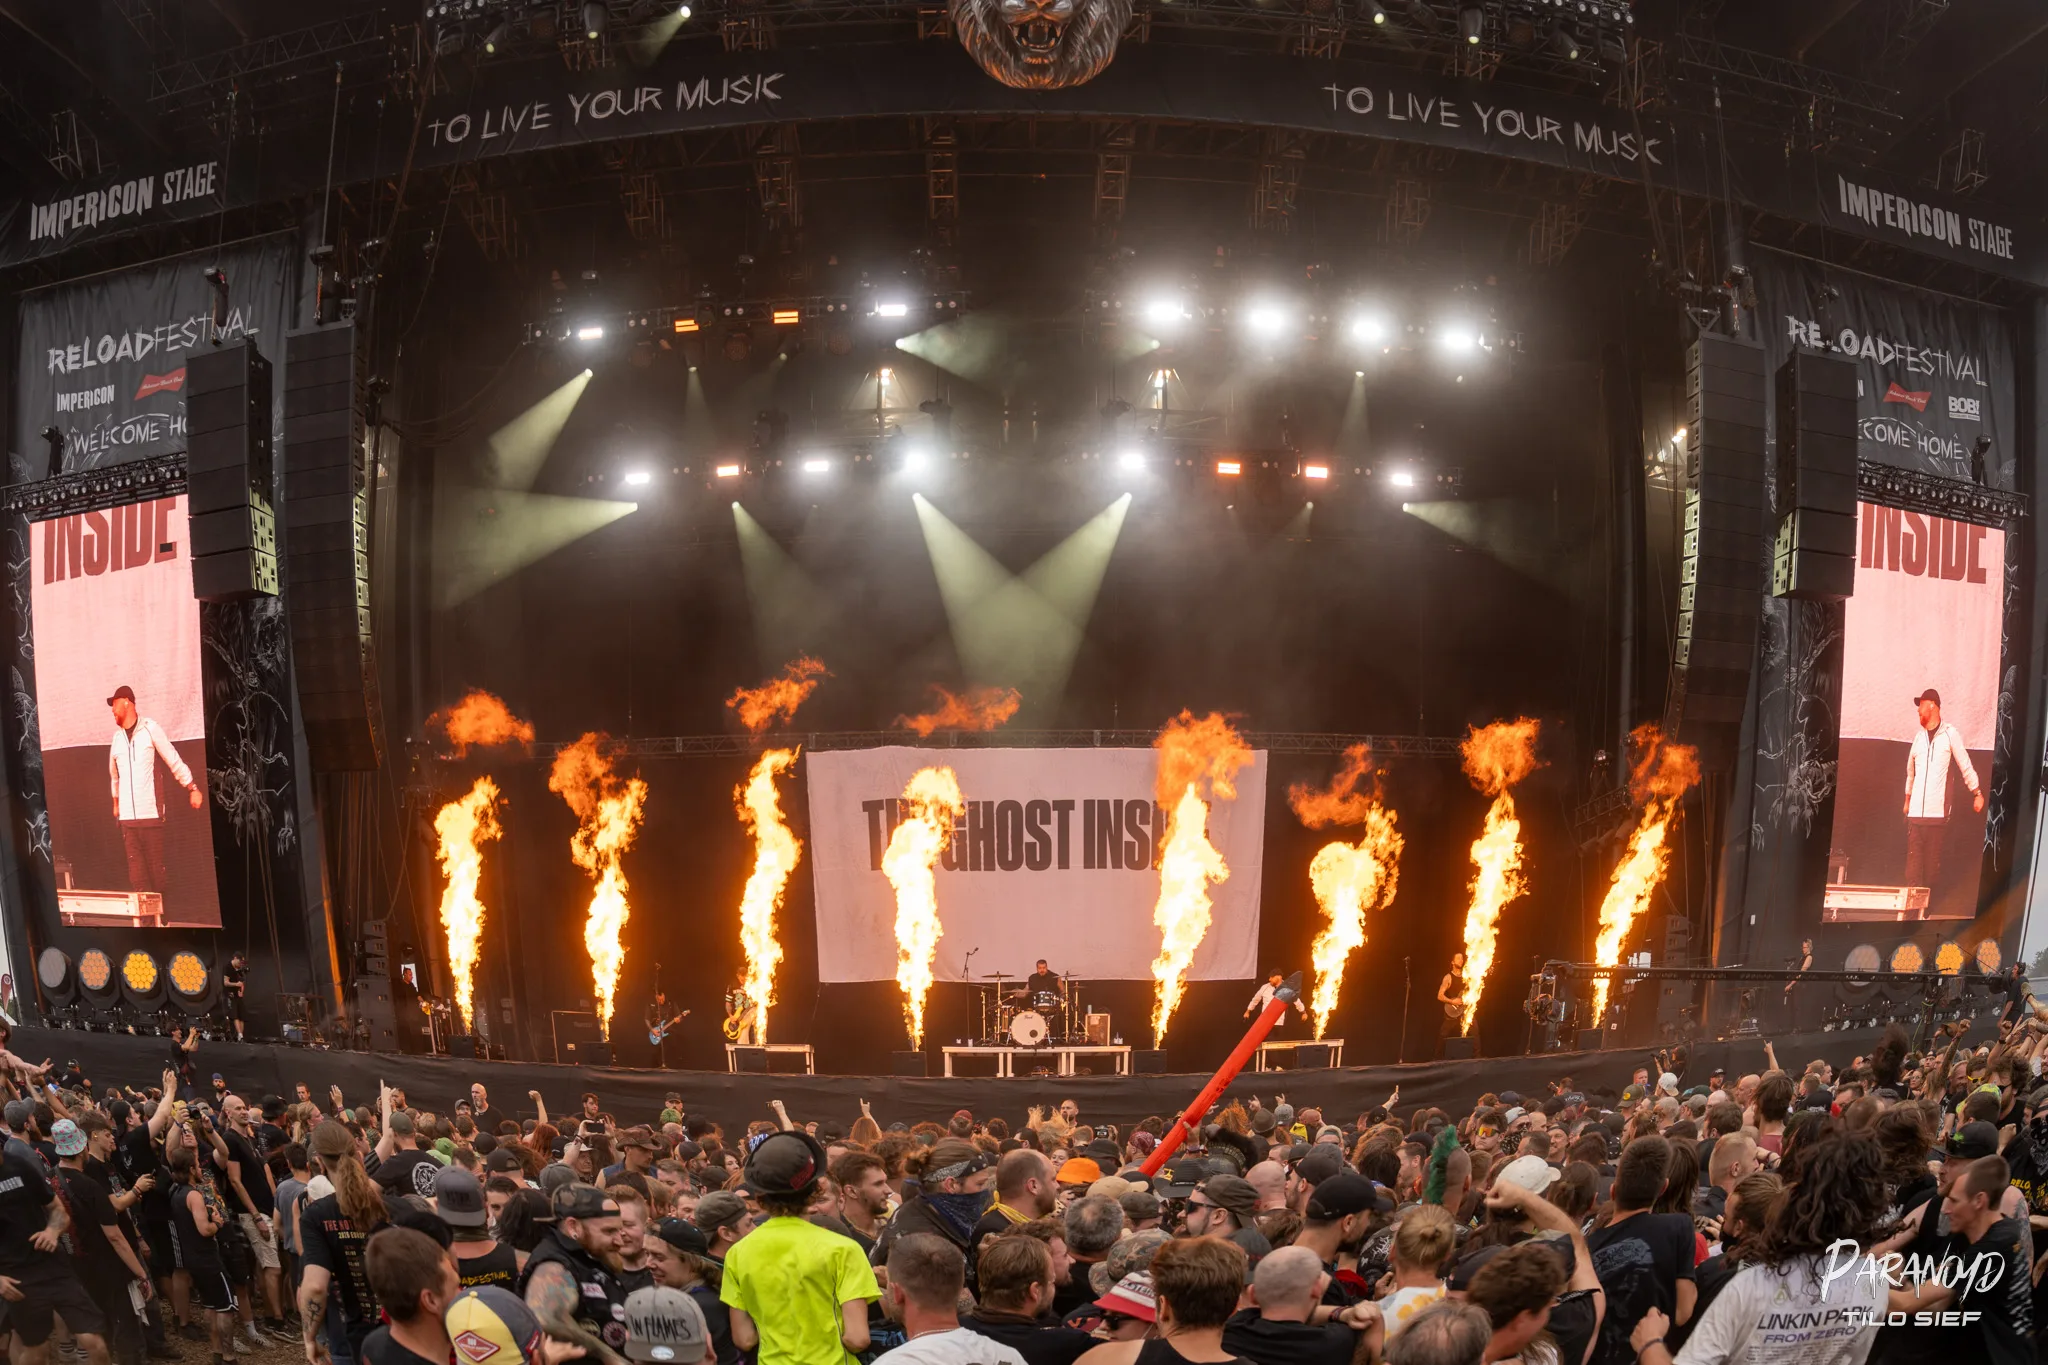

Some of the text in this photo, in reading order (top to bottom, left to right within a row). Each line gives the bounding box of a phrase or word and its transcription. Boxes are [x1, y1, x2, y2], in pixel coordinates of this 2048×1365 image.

[428, 72, 785, 147] TO LIVE YOUR MUSIC
[1321, 82, 1662, 165] TO LIVE YOUR MUSC
[30, 161, 218, 241] IMPERICON STAGE
[1838, 173, 2014, 260] IMPERICON STAGE
[47, 303, 260, 376] RELOADFESTVAL
[56, 384, 115, 412] IMPERICON
[1948, 395, 1980, 415] BOB!
[73, 420, 161, 455] WELCOME
[1917, 434, 1964, 460] HOME
[44, 496, 177, 586] INSIDE
[1860, 502, 1987, 585] INSIDE
[941, 798, 1075, 873] GHOST
[1082, 798, 1212, 872] INSI
[644, 1313, 692, 1343] FLAMES
[1757, 1305, 1874, 1331] LINKIN PARK
[1763, 1326, 1857, 1344] FROM ZERO
